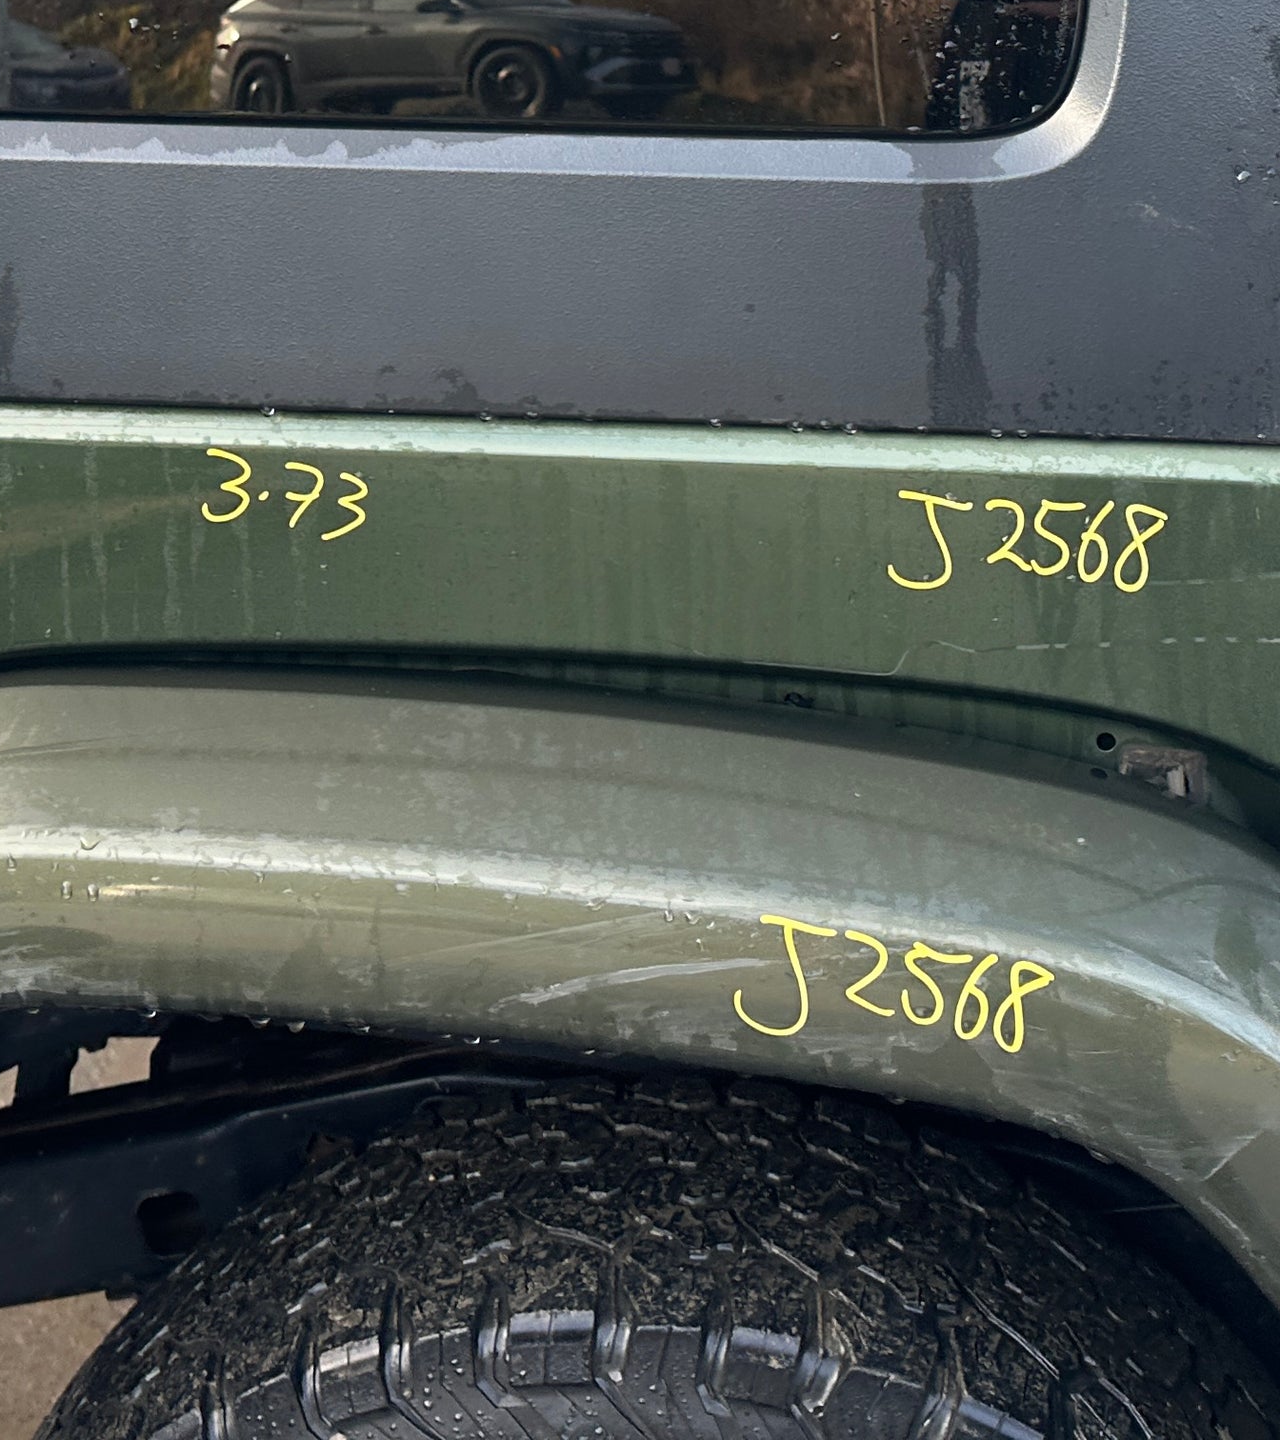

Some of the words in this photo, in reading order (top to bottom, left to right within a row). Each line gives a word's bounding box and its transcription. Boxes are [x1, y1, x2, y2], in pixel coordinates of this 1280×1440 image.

[200, 447, 369, 542] 3.73
[887, 489, 1169, 593] J2568
[733, 913, 1056, 1054] J2568
